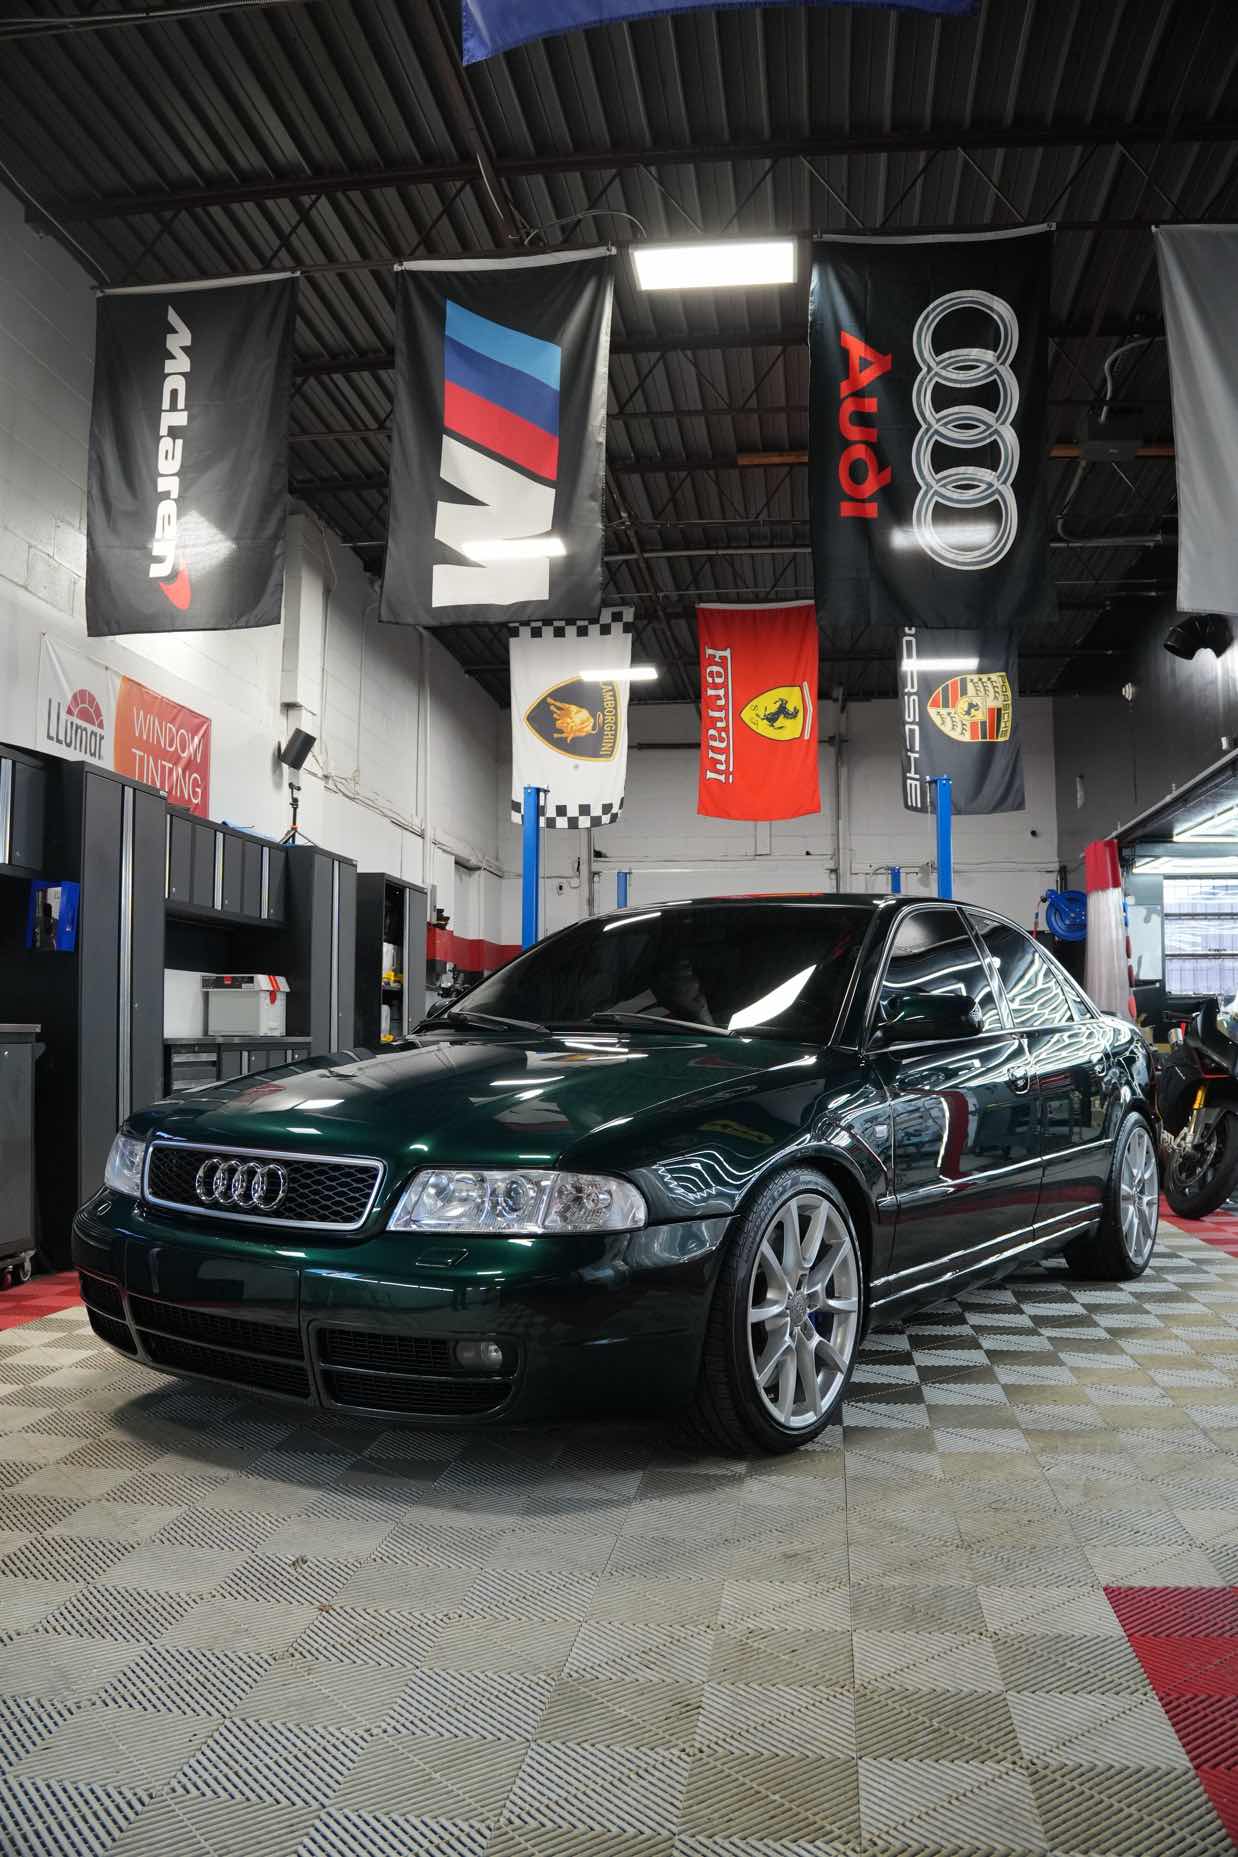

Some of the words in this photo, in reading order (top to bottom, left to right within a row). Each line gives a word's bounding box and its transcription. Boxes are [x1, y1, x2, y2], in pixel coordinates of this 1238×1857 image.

[149, 304, 192, 578] McLaren
[839, 329, 893, 519] Audi
[432, 434, 556, 607] M
[46, 697, 105, 760] LLumar
[131, 748, 202, 804] TINTING
[132, 706, 205, 764] WINDOW
[600, 681, 616, 755] AMBORGHINI
[705, 646, 734, 785] Ferrari
[902, 626, 921, 808] ORSCHE
